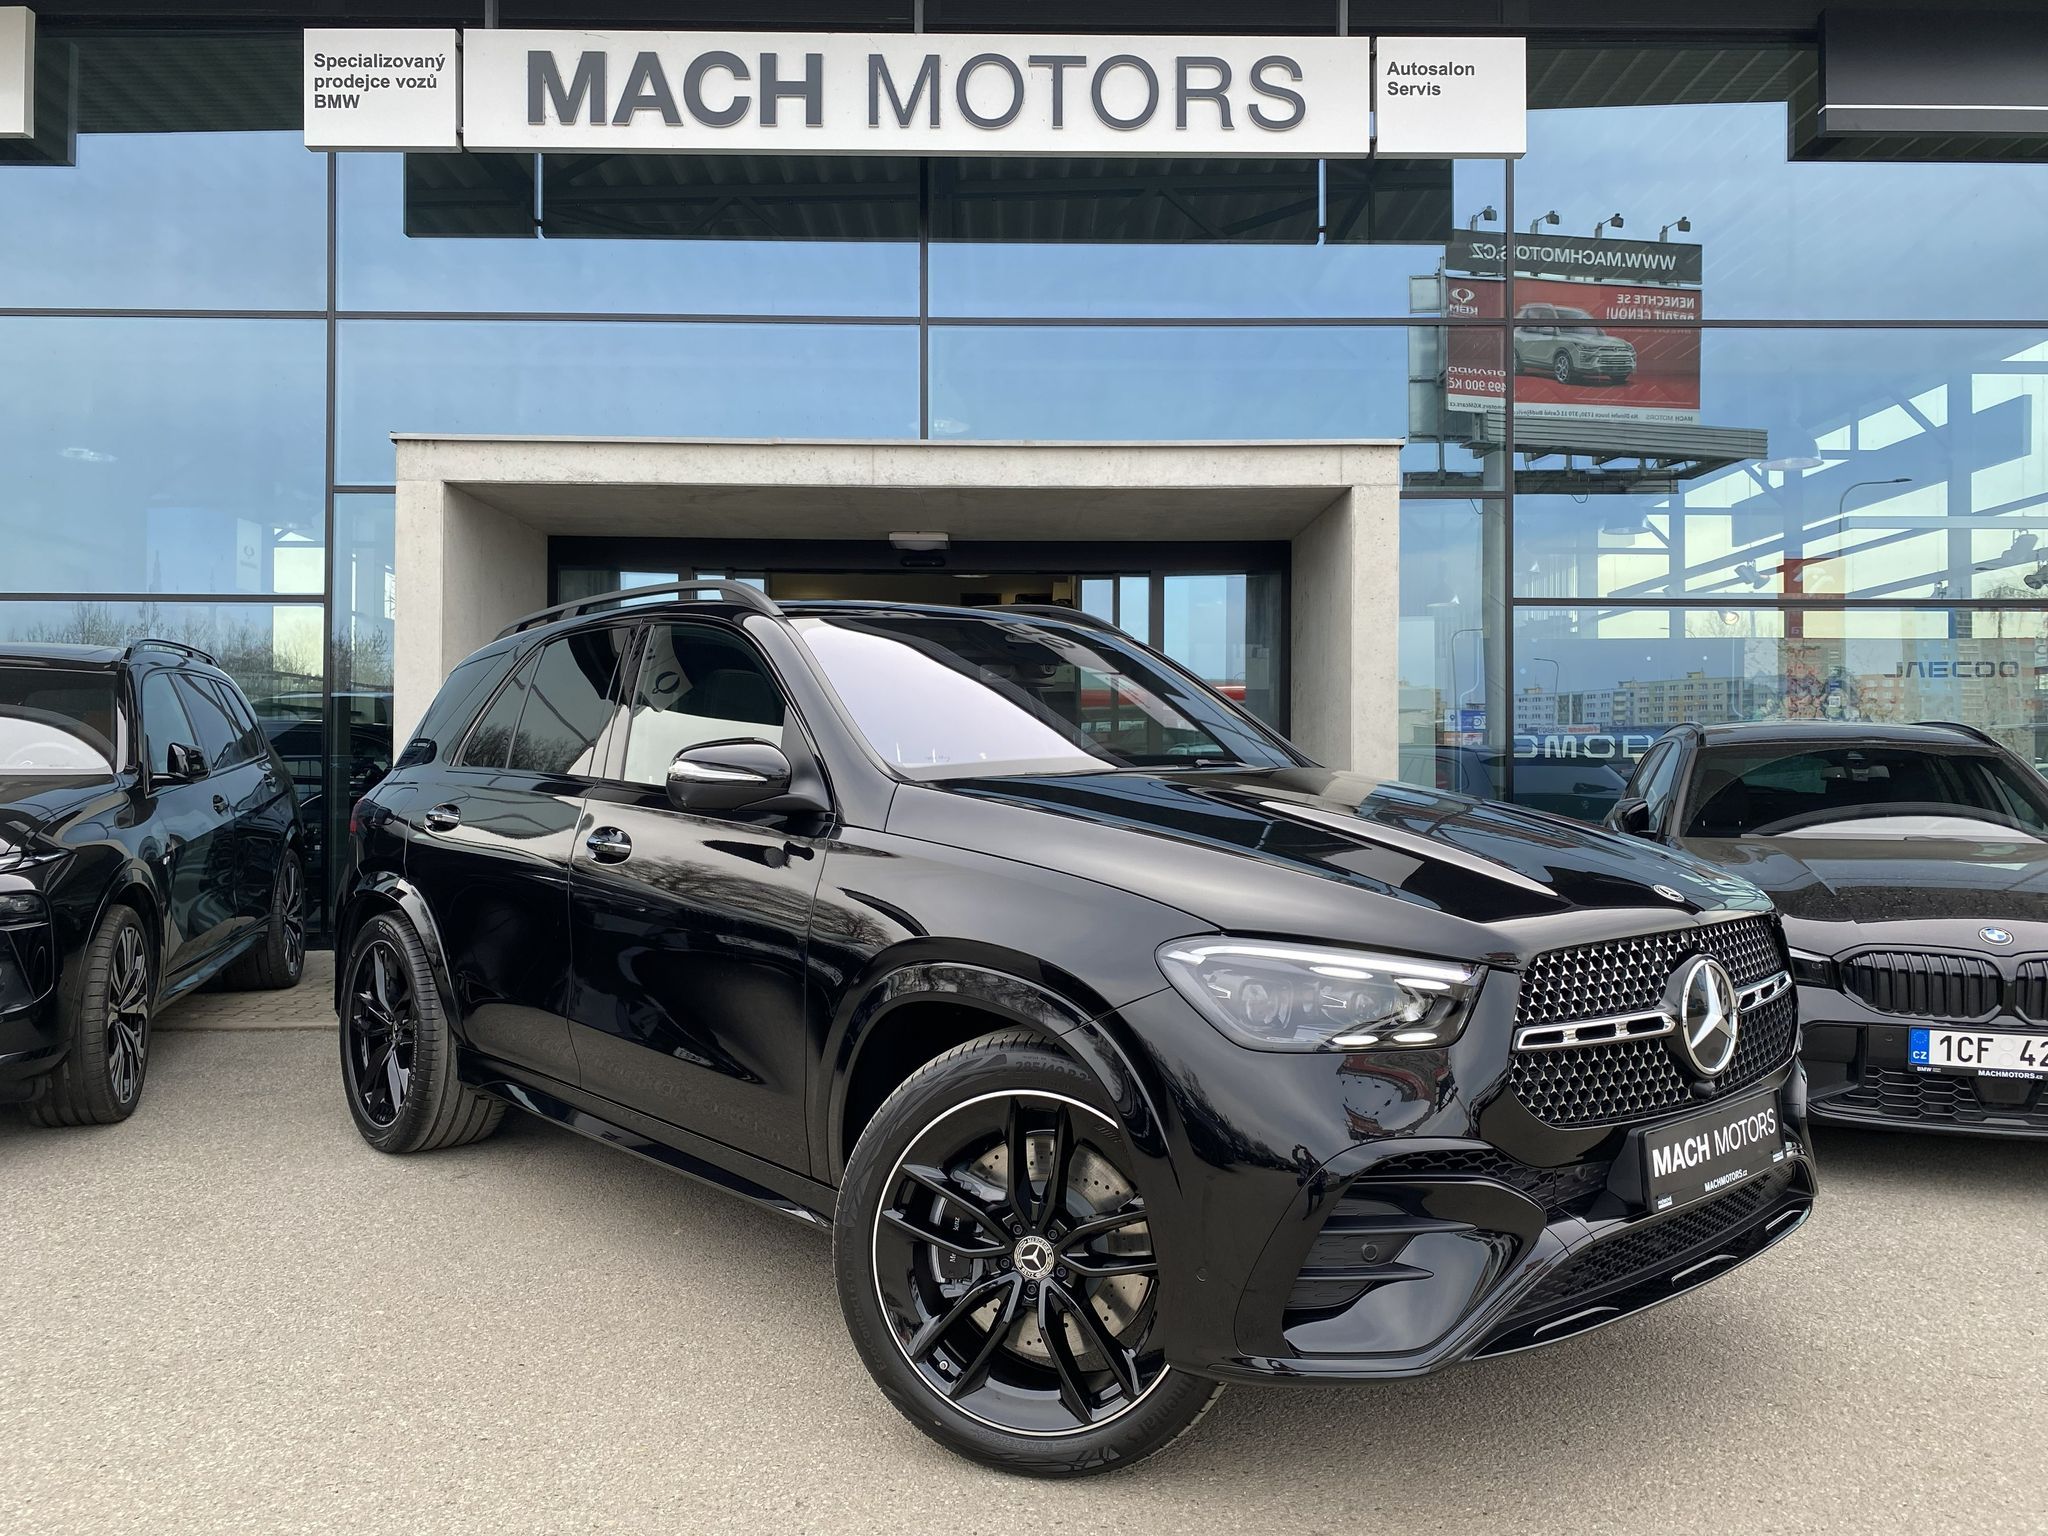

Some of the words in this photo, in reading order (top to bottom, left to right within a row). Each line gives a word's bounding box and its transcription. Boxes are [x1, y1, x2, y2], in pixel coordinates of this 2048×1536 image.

[313, 52, 446, 72] Specializovaný
[1386, 61, 1476, 77] Autosalon
[313, 74, 391, 92] prodejce
[395, 73, 438, 90] vozů
[527, 50, 824, 129] MACH
[868, 53, 1307, 131] MOTORS
[1386, 81, 1443, 97] Servis
[313, 94, 360, 109] BMW
[1883, 661, 2019, 678] JAECOO
[1912, 1050, 1928, 1060] CZ
[1939, 1035, 1994, 1064] 1CF
[1652, 1132, 1711, 1178] MACH
[1713, 1107, 1777, 1157] MOTORS
